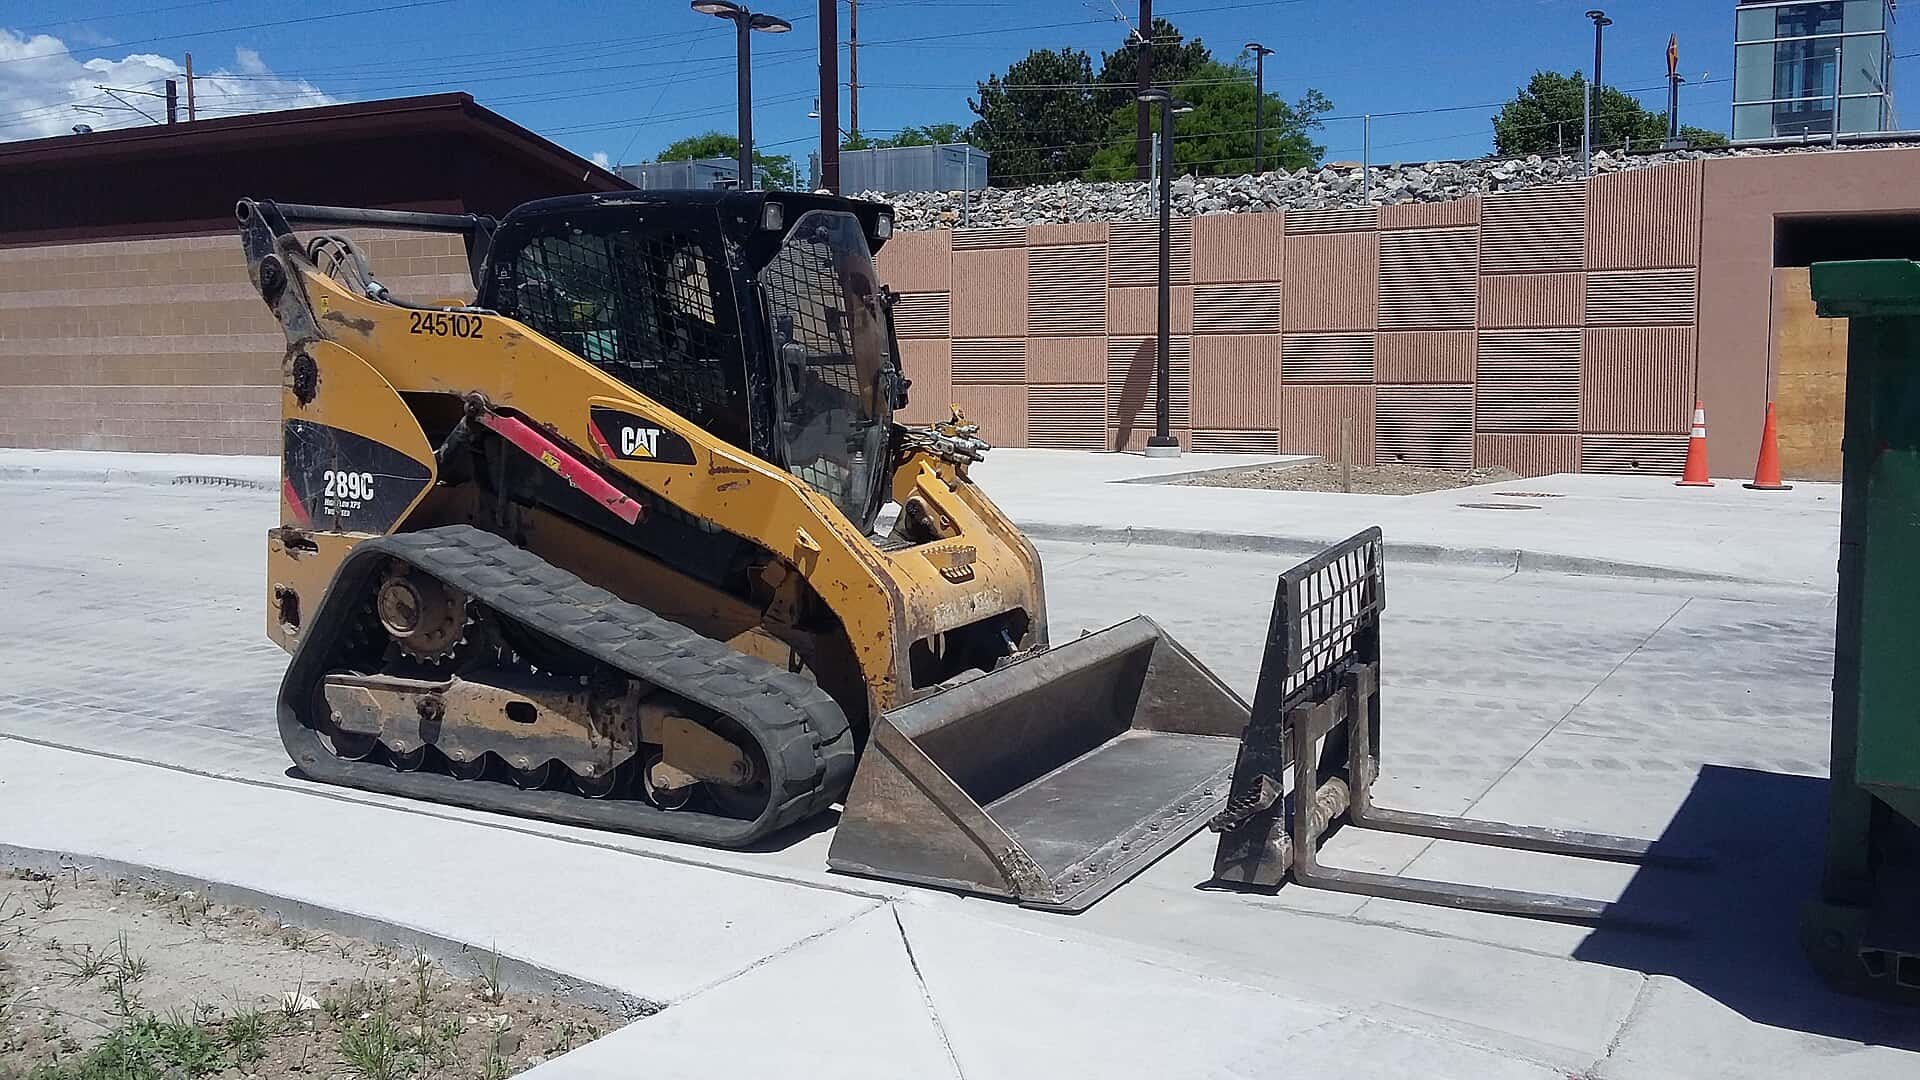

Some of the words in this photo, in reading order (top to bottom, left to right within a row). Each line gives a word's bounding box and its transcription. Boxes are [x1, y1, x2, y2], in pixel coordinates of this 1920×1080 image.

[410, 312, 483, 339] 245102
[621, 426, 660, 458] CAT
[323, 470, 374, 500] 289C
